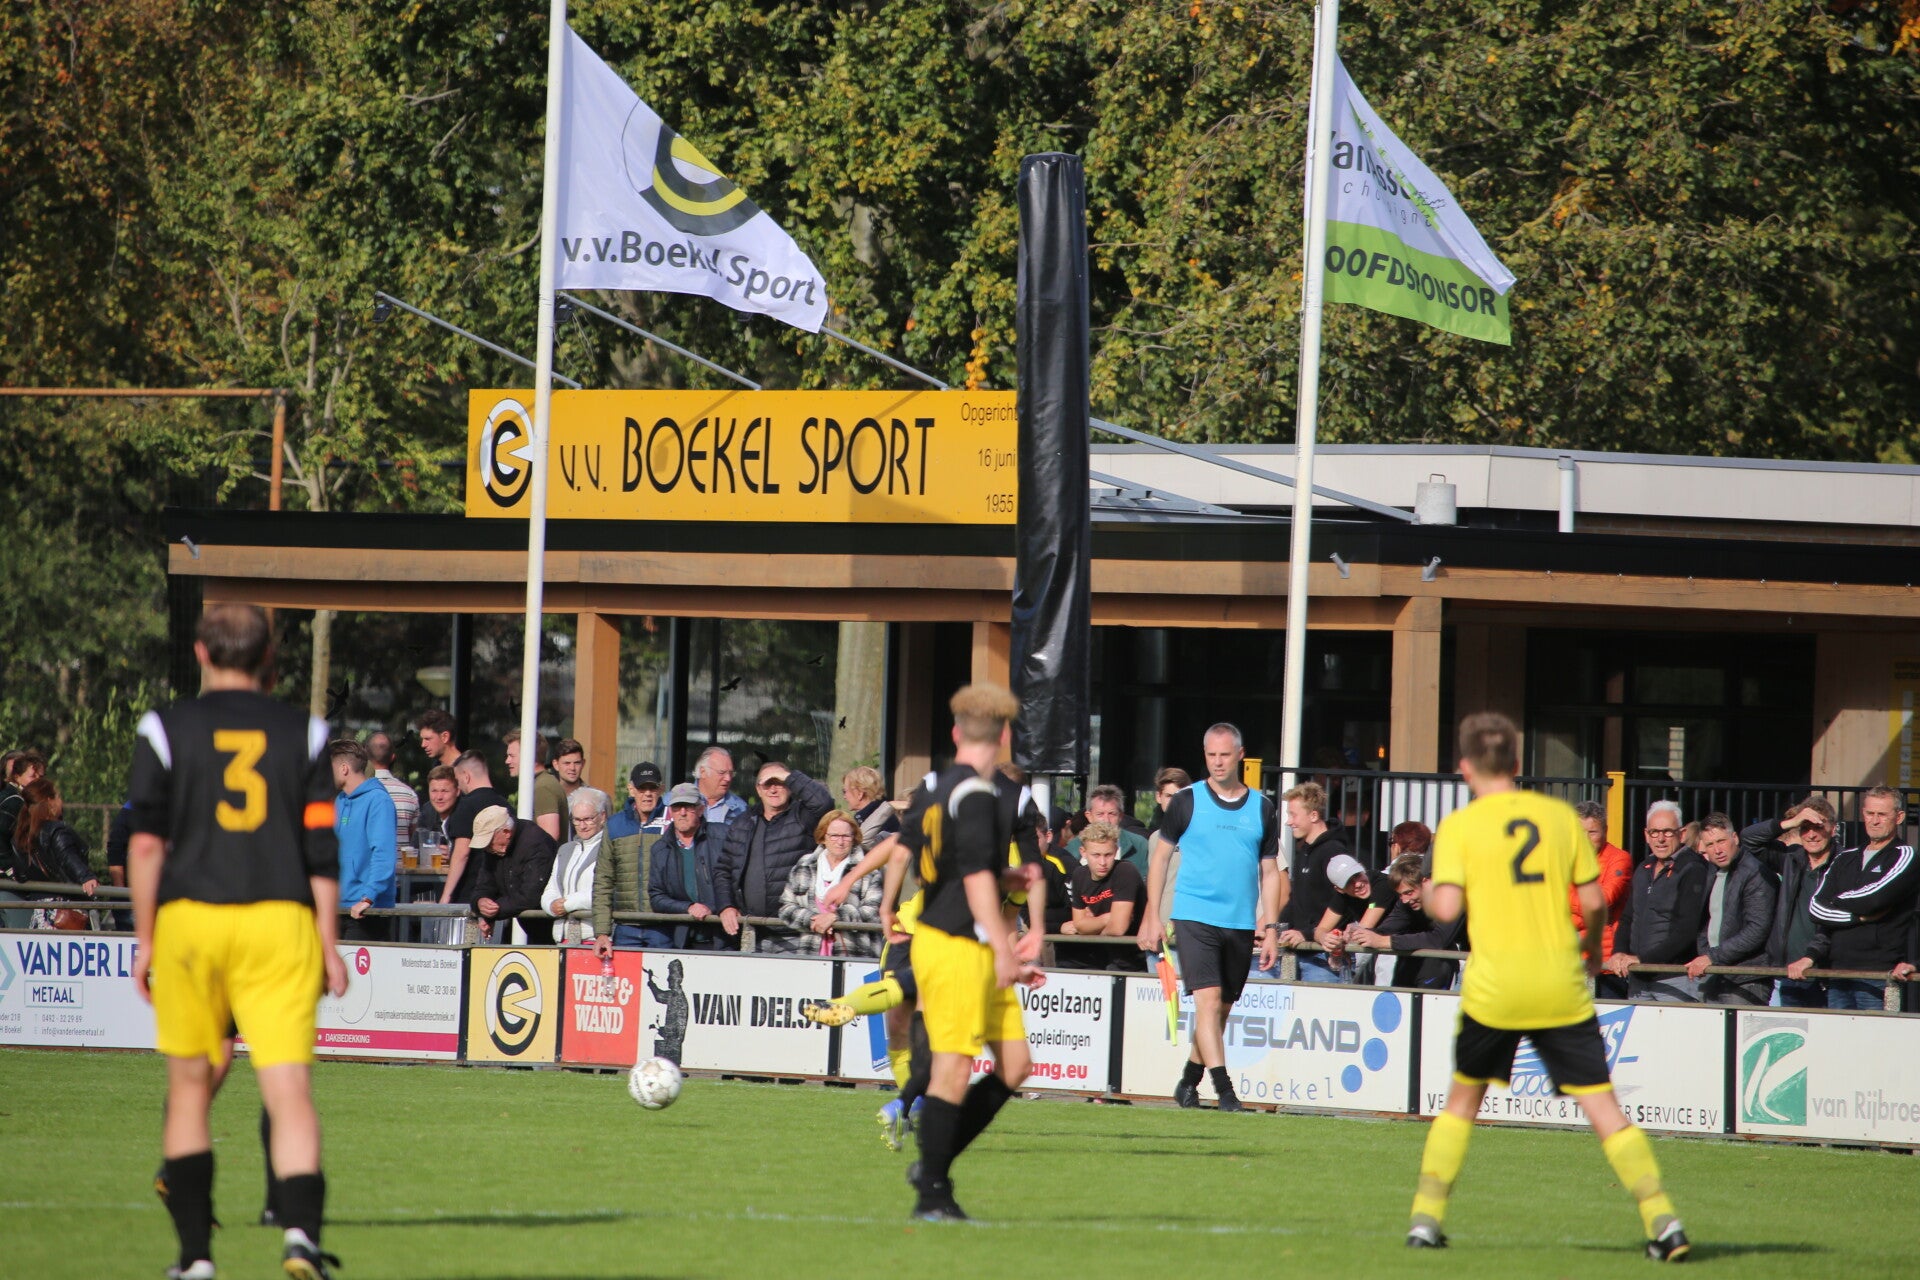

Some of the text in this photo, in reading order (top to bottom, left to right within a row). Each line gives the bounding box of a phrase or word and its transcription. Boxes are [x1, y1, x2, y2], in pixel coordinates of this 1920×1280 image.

[726, 254, 816, 306] Sport
[622, 416, 780, 494] BOEKEL
[798, 416, 935, 496] SPORT
[978, 448, 1016, 472] 16 juni
[985, 494, 1014, 513] 1955
[213, 728, 268, 832] 3
[1505, 818, 1545, 884] 2
[16, 941, 62, 976] VAN
[67, 941, 111, 977] DER
[32, 986, 75, 1003] METAAL
[692, 993, 741, 1026] VAN
[1021, 987, 1102, 1022] Vogelzang
[574, 1004, 624, 1035] WAND
[325, 1033, 371, 1044] DAKBEDEKKING
[1024, 1028, 1091, 1051] -opleidingen
[1240, 1073, 1333, 1101] boekel
[1505, 1097, 1552, 1117] TRUCK
[1559, 1100, 1567, 1118] &
[1637, 1104, 1693, 1124] SERVICE
[1700, 1108, 1718, 1126] BV
[1812, 1096, 1848, 1118] van
